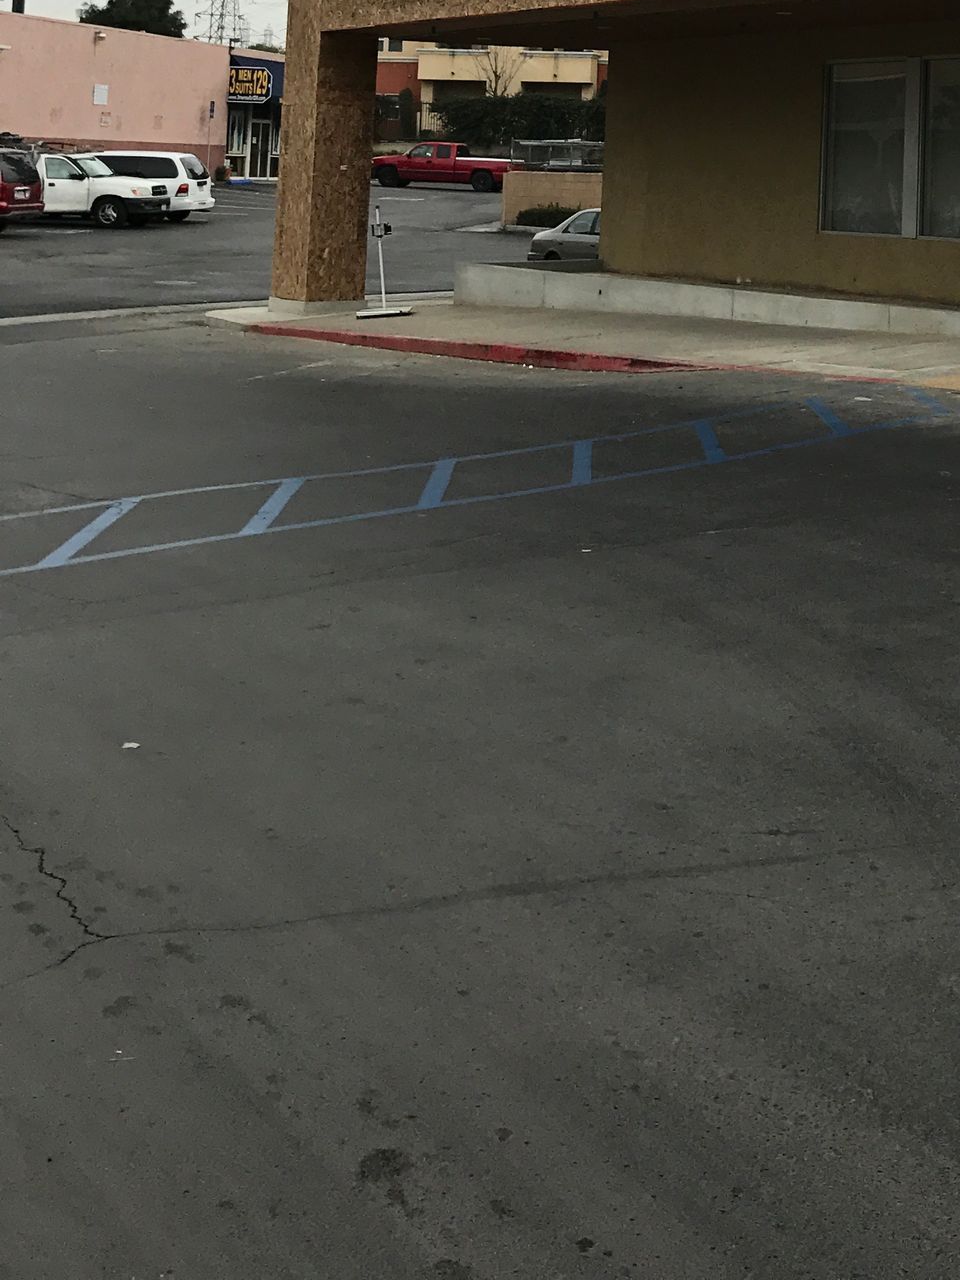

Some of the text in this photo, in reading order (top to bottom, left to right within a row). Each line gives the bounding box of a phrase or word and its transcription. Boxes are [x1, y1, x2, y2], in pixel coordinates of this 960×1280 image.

[229, 69, 236, 93] 3
[238, 70, 252, 80] MEN
[253, 70, 268, 94] 129
[235, 82, 253, 94] SUITS
